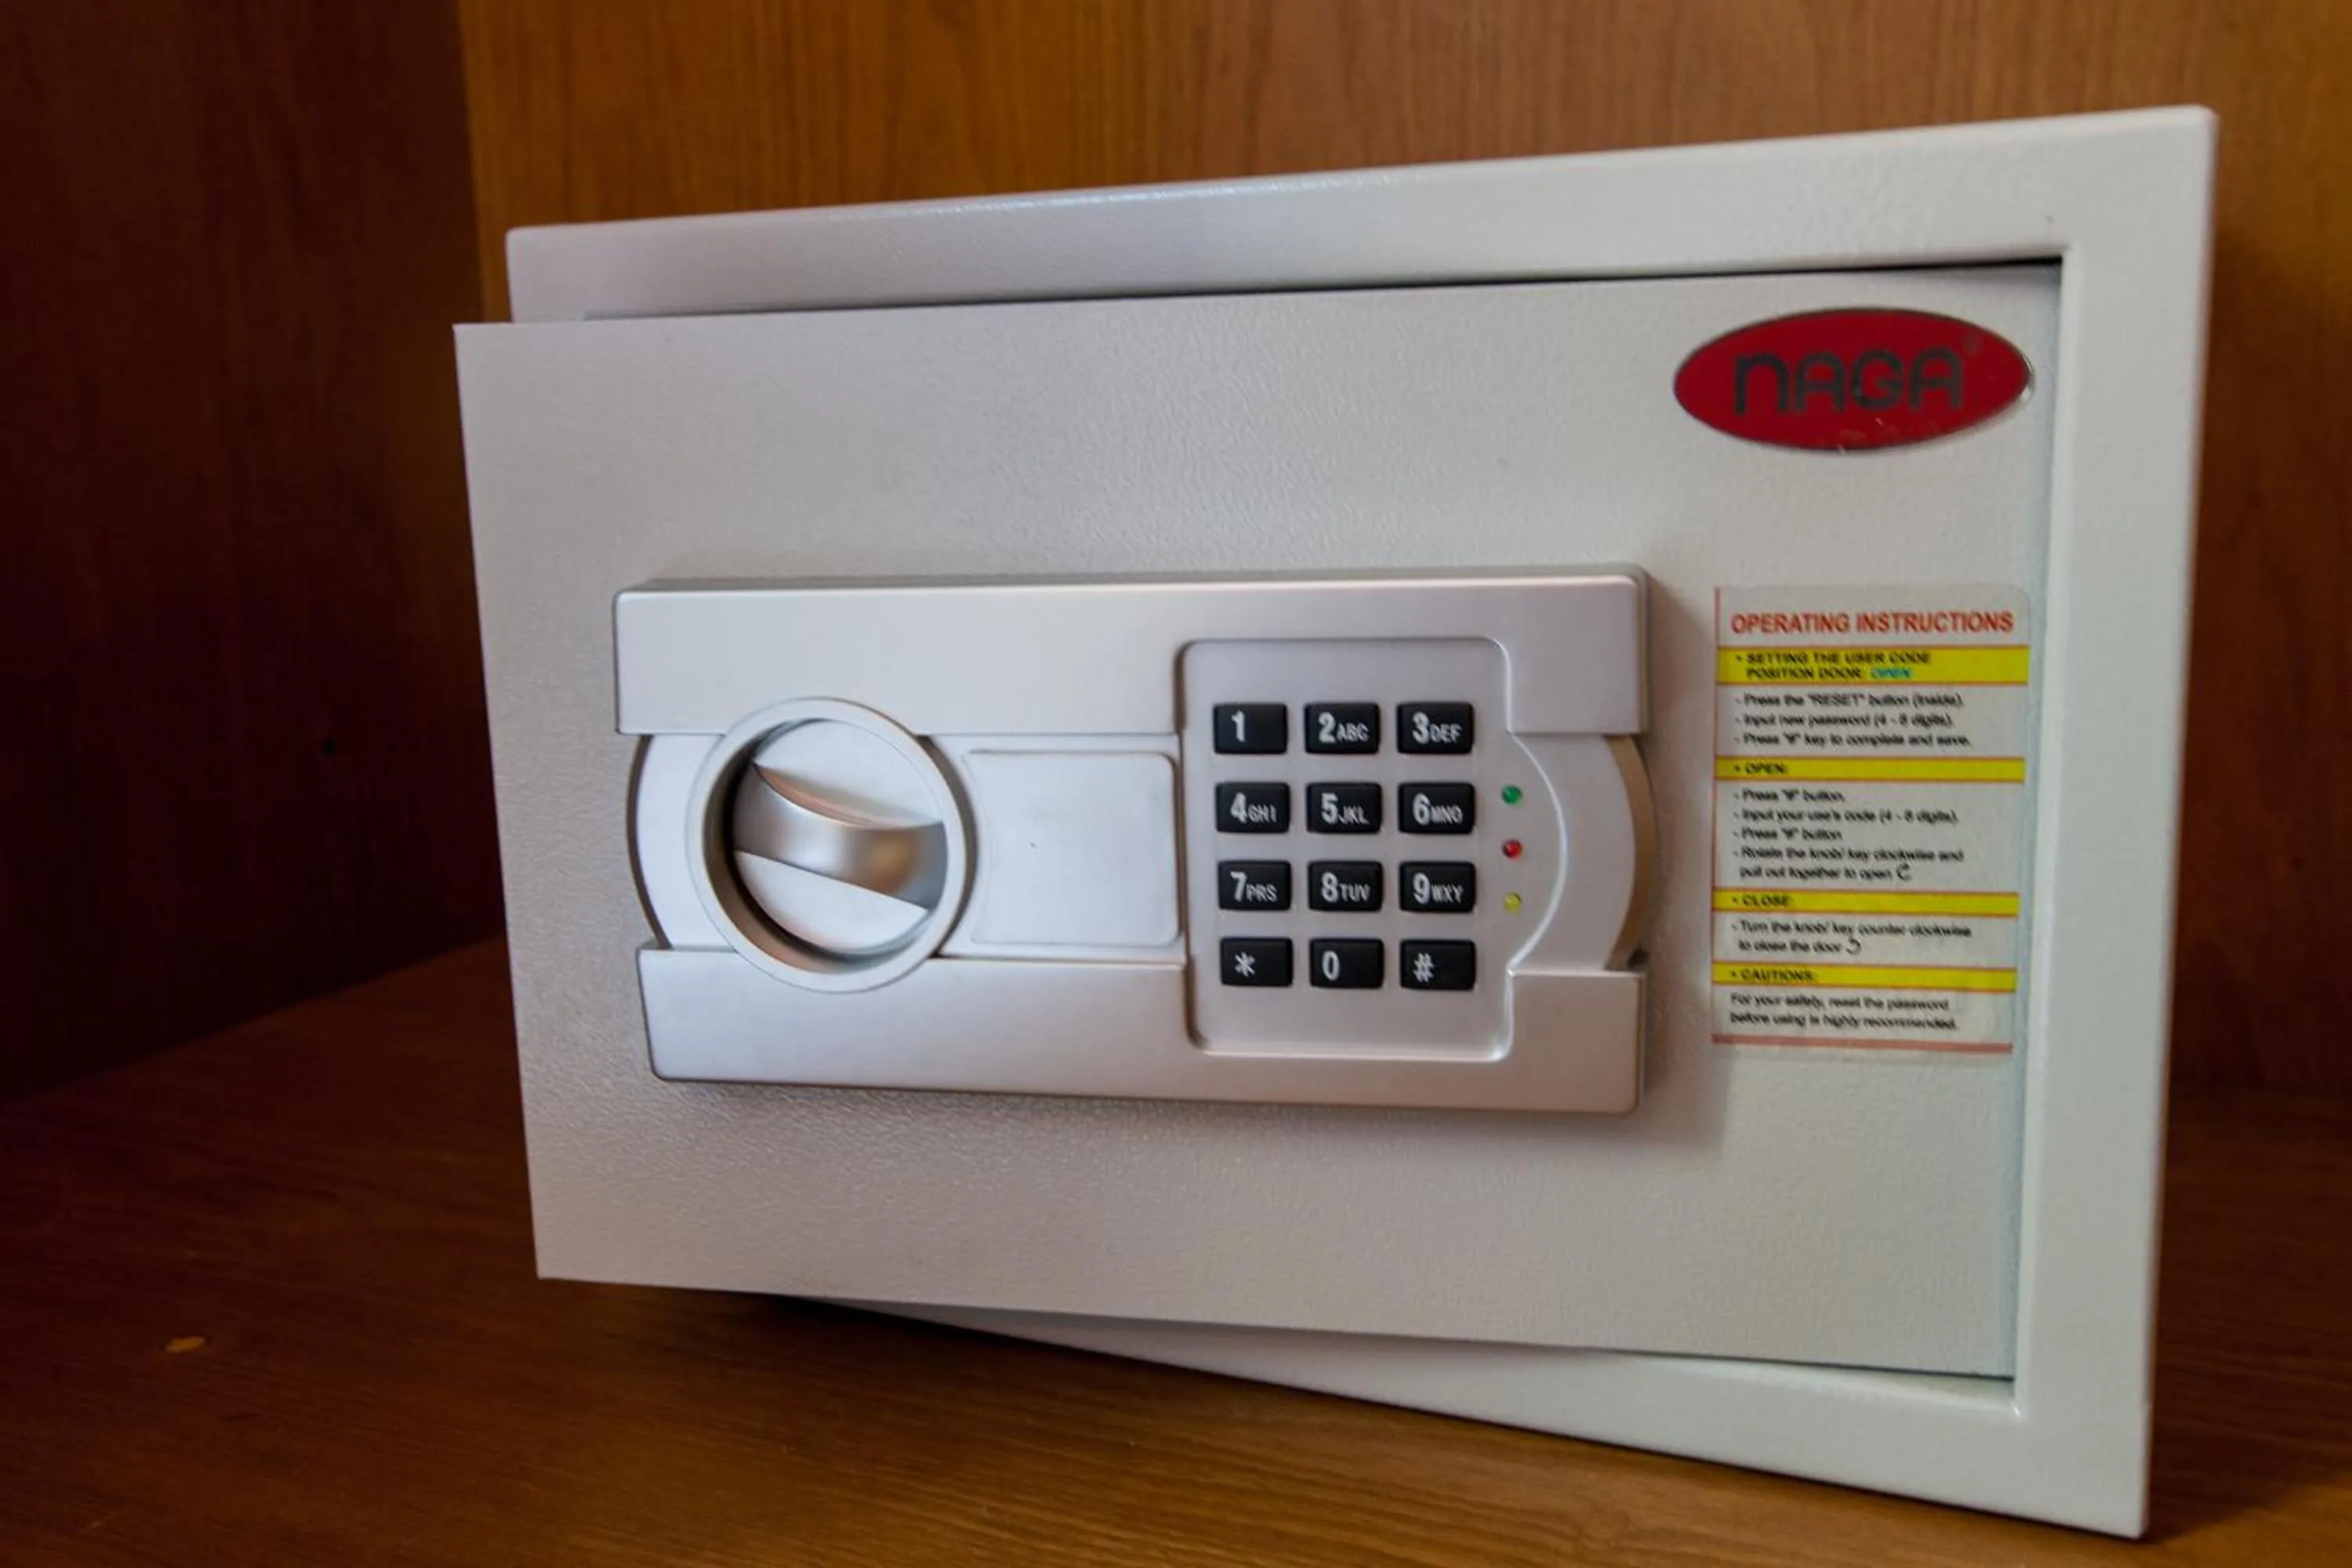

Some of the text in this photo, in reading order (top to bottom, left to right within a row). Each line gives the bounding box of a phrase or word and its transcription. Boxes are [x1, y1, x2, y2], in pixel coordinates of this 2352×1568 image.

[1731, 611, 2015, 633] OPERATING INSTRUCTIONS
[1747, 652, 1930, 664] SETTING THE USER CODE
[1746, 667, 1814, 679] POSITION
[1871, 667, 1911, 679] OPEN
[1744, 693, 1780, 706] Press
[1784, 694, 1805, 706] the
[1868, 693, 1910, 706] button
[1231, 710, 1246, 742] 1
[1809, 713, 1871, 728] password
[1744, 732, 1780, 745] Press
[1805, 734, 1827, 747] key
[1830, 732, 1843, 745] to
[1846, 733, 1905, 748] complete
[1907, 733, 1933, 746] and
[1742, 787, 1779, 800] Press
[1844, 810, 1876, 821] code
[1742, 827, 1778, 840] Press
[1741, 846, 1783, 858] Rotate
[1785, 847, 1806, 858] the
[1874, 849, 1935, 861] clockwise
[1938, 850, 1964, 862] and
[1765, 867, 1785, 879] out
[1788, 866, 1839, 880] together
[1771, 921, 1791, 933] the
[1909, 924, 1972, 938] clockwise
[1738, 941, 1751, 951] to
[1754, 941, 1787, 952] close
[1790, 941, 1810, 952] the
[1323, 950, 1339, 980] 0
[1730, 993, 1751, 1005] For
[1863, 997, 1884, 1008] the
[1886, 998, 1949, 1011] password
[1730, 1012, 1769, 1024] before
